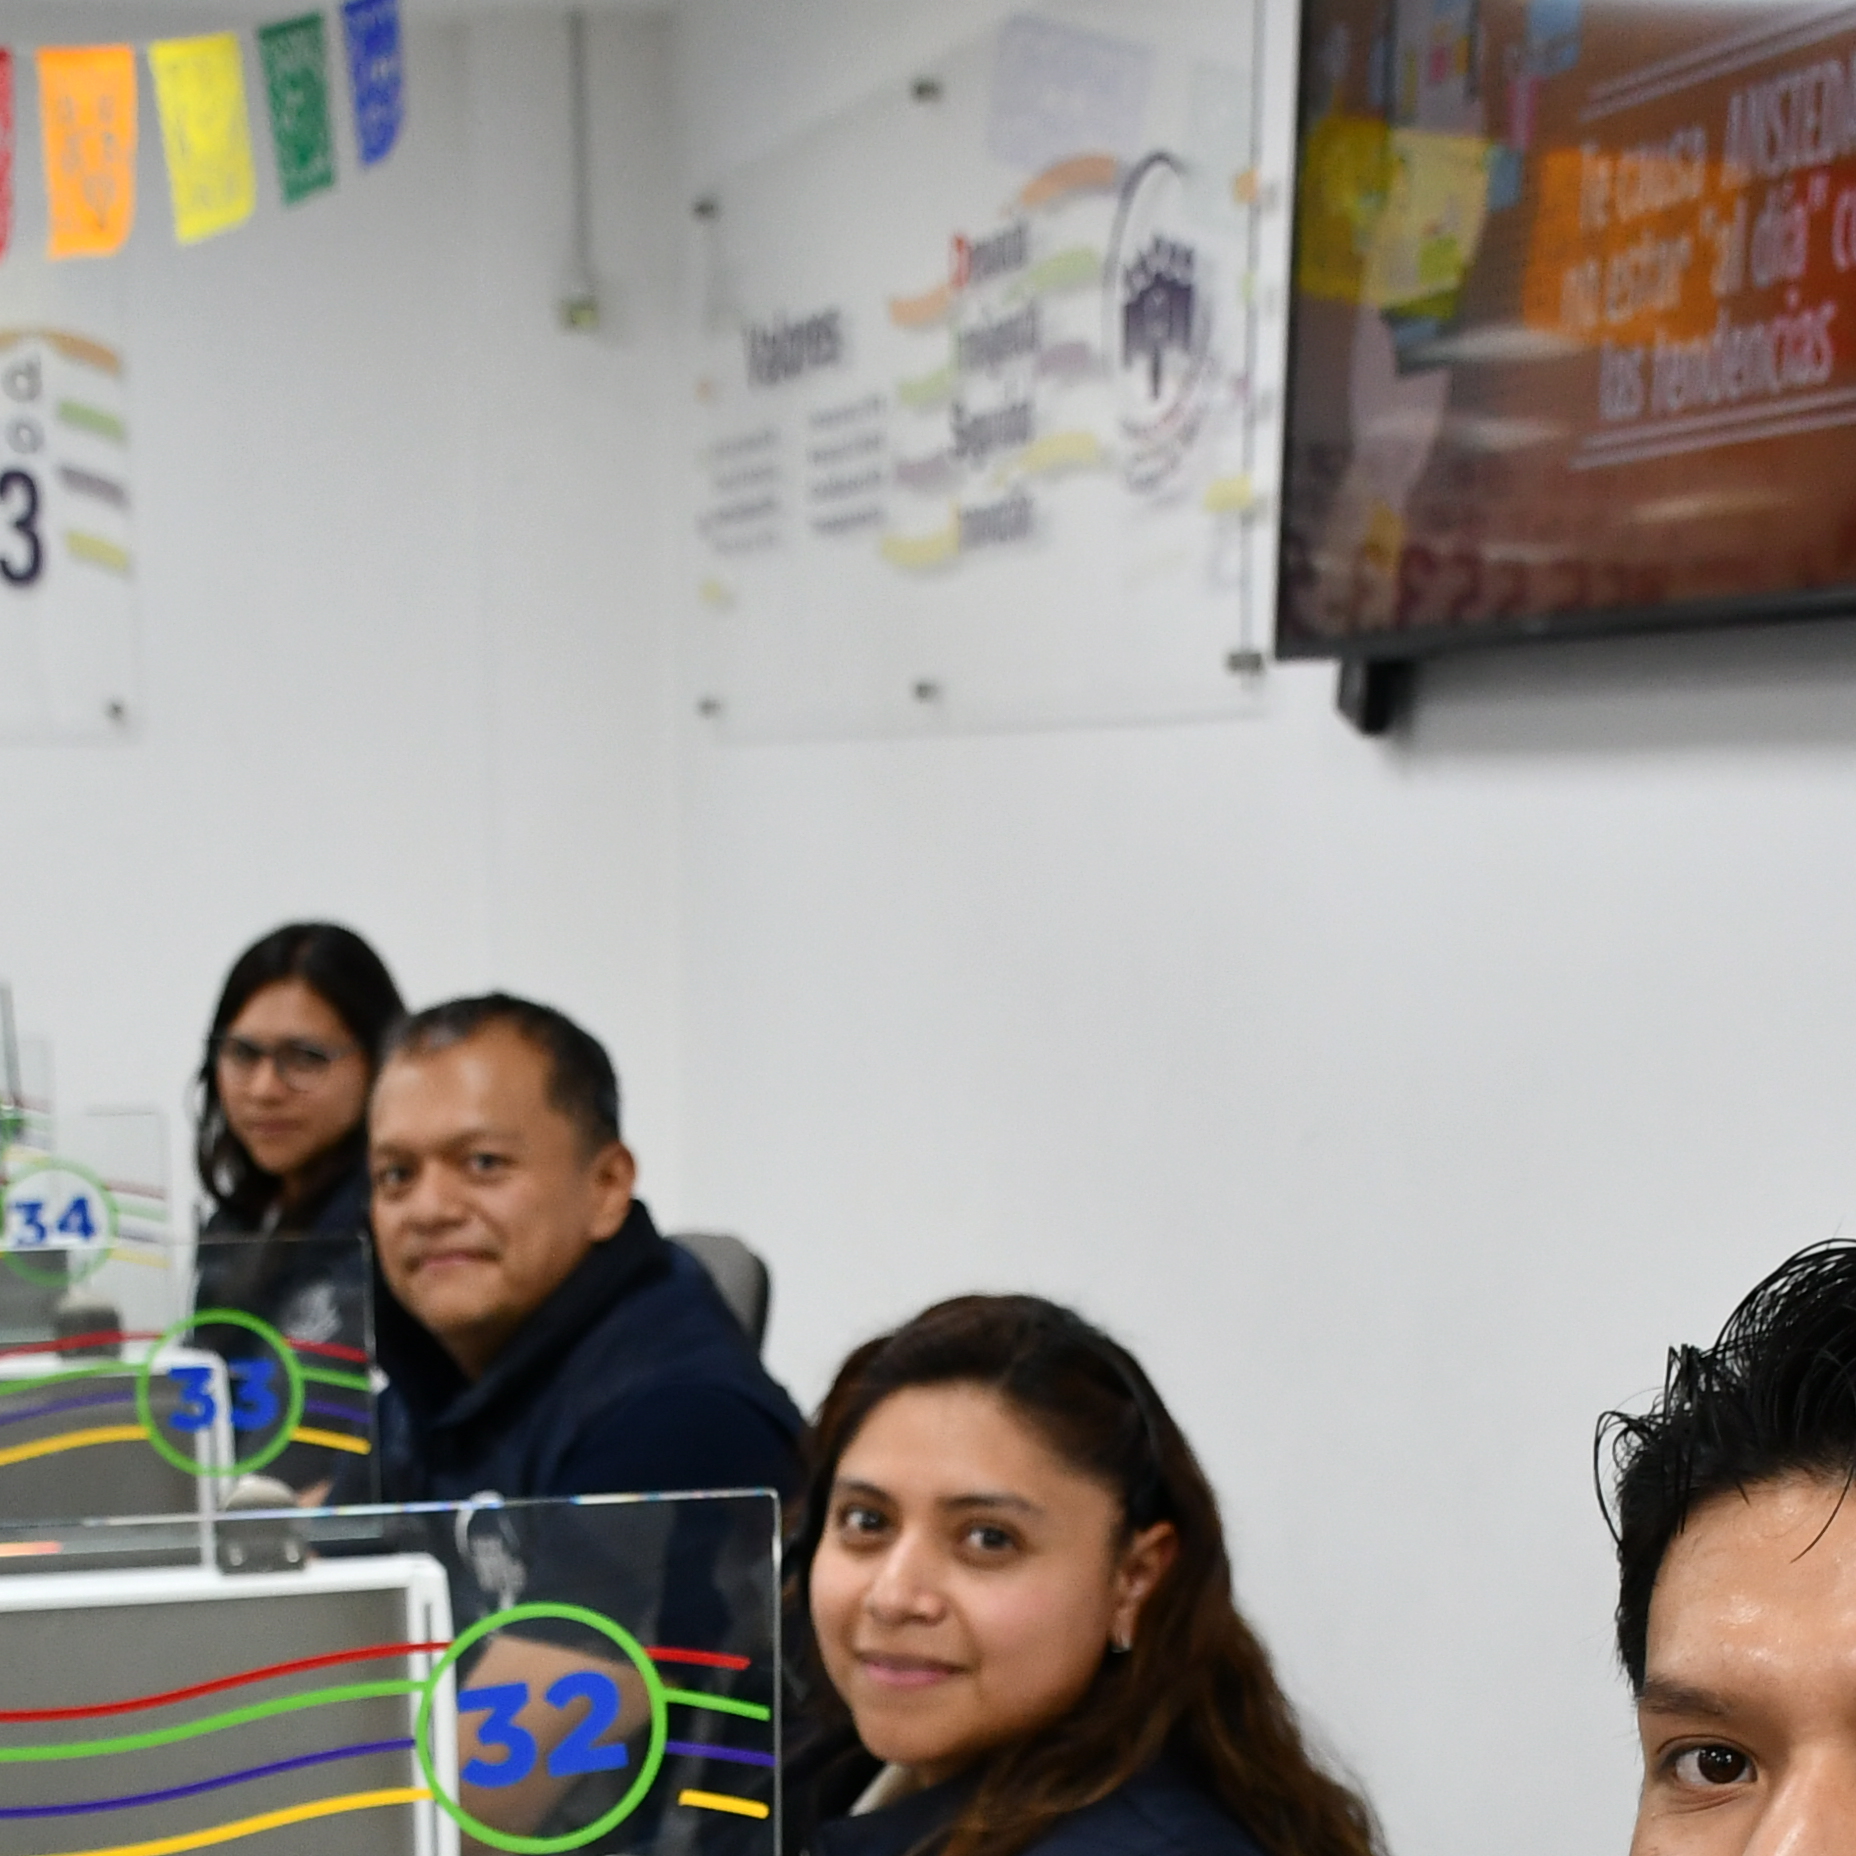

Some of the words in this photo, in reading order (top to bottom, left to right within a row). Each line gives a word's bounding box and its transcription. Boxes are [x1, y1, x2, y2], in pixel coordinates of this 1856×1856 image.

[12, 1196, 96, 1249] 34
[167, 1357, 279, 1432] 33
[457, 1670, 629, 1788] 32
